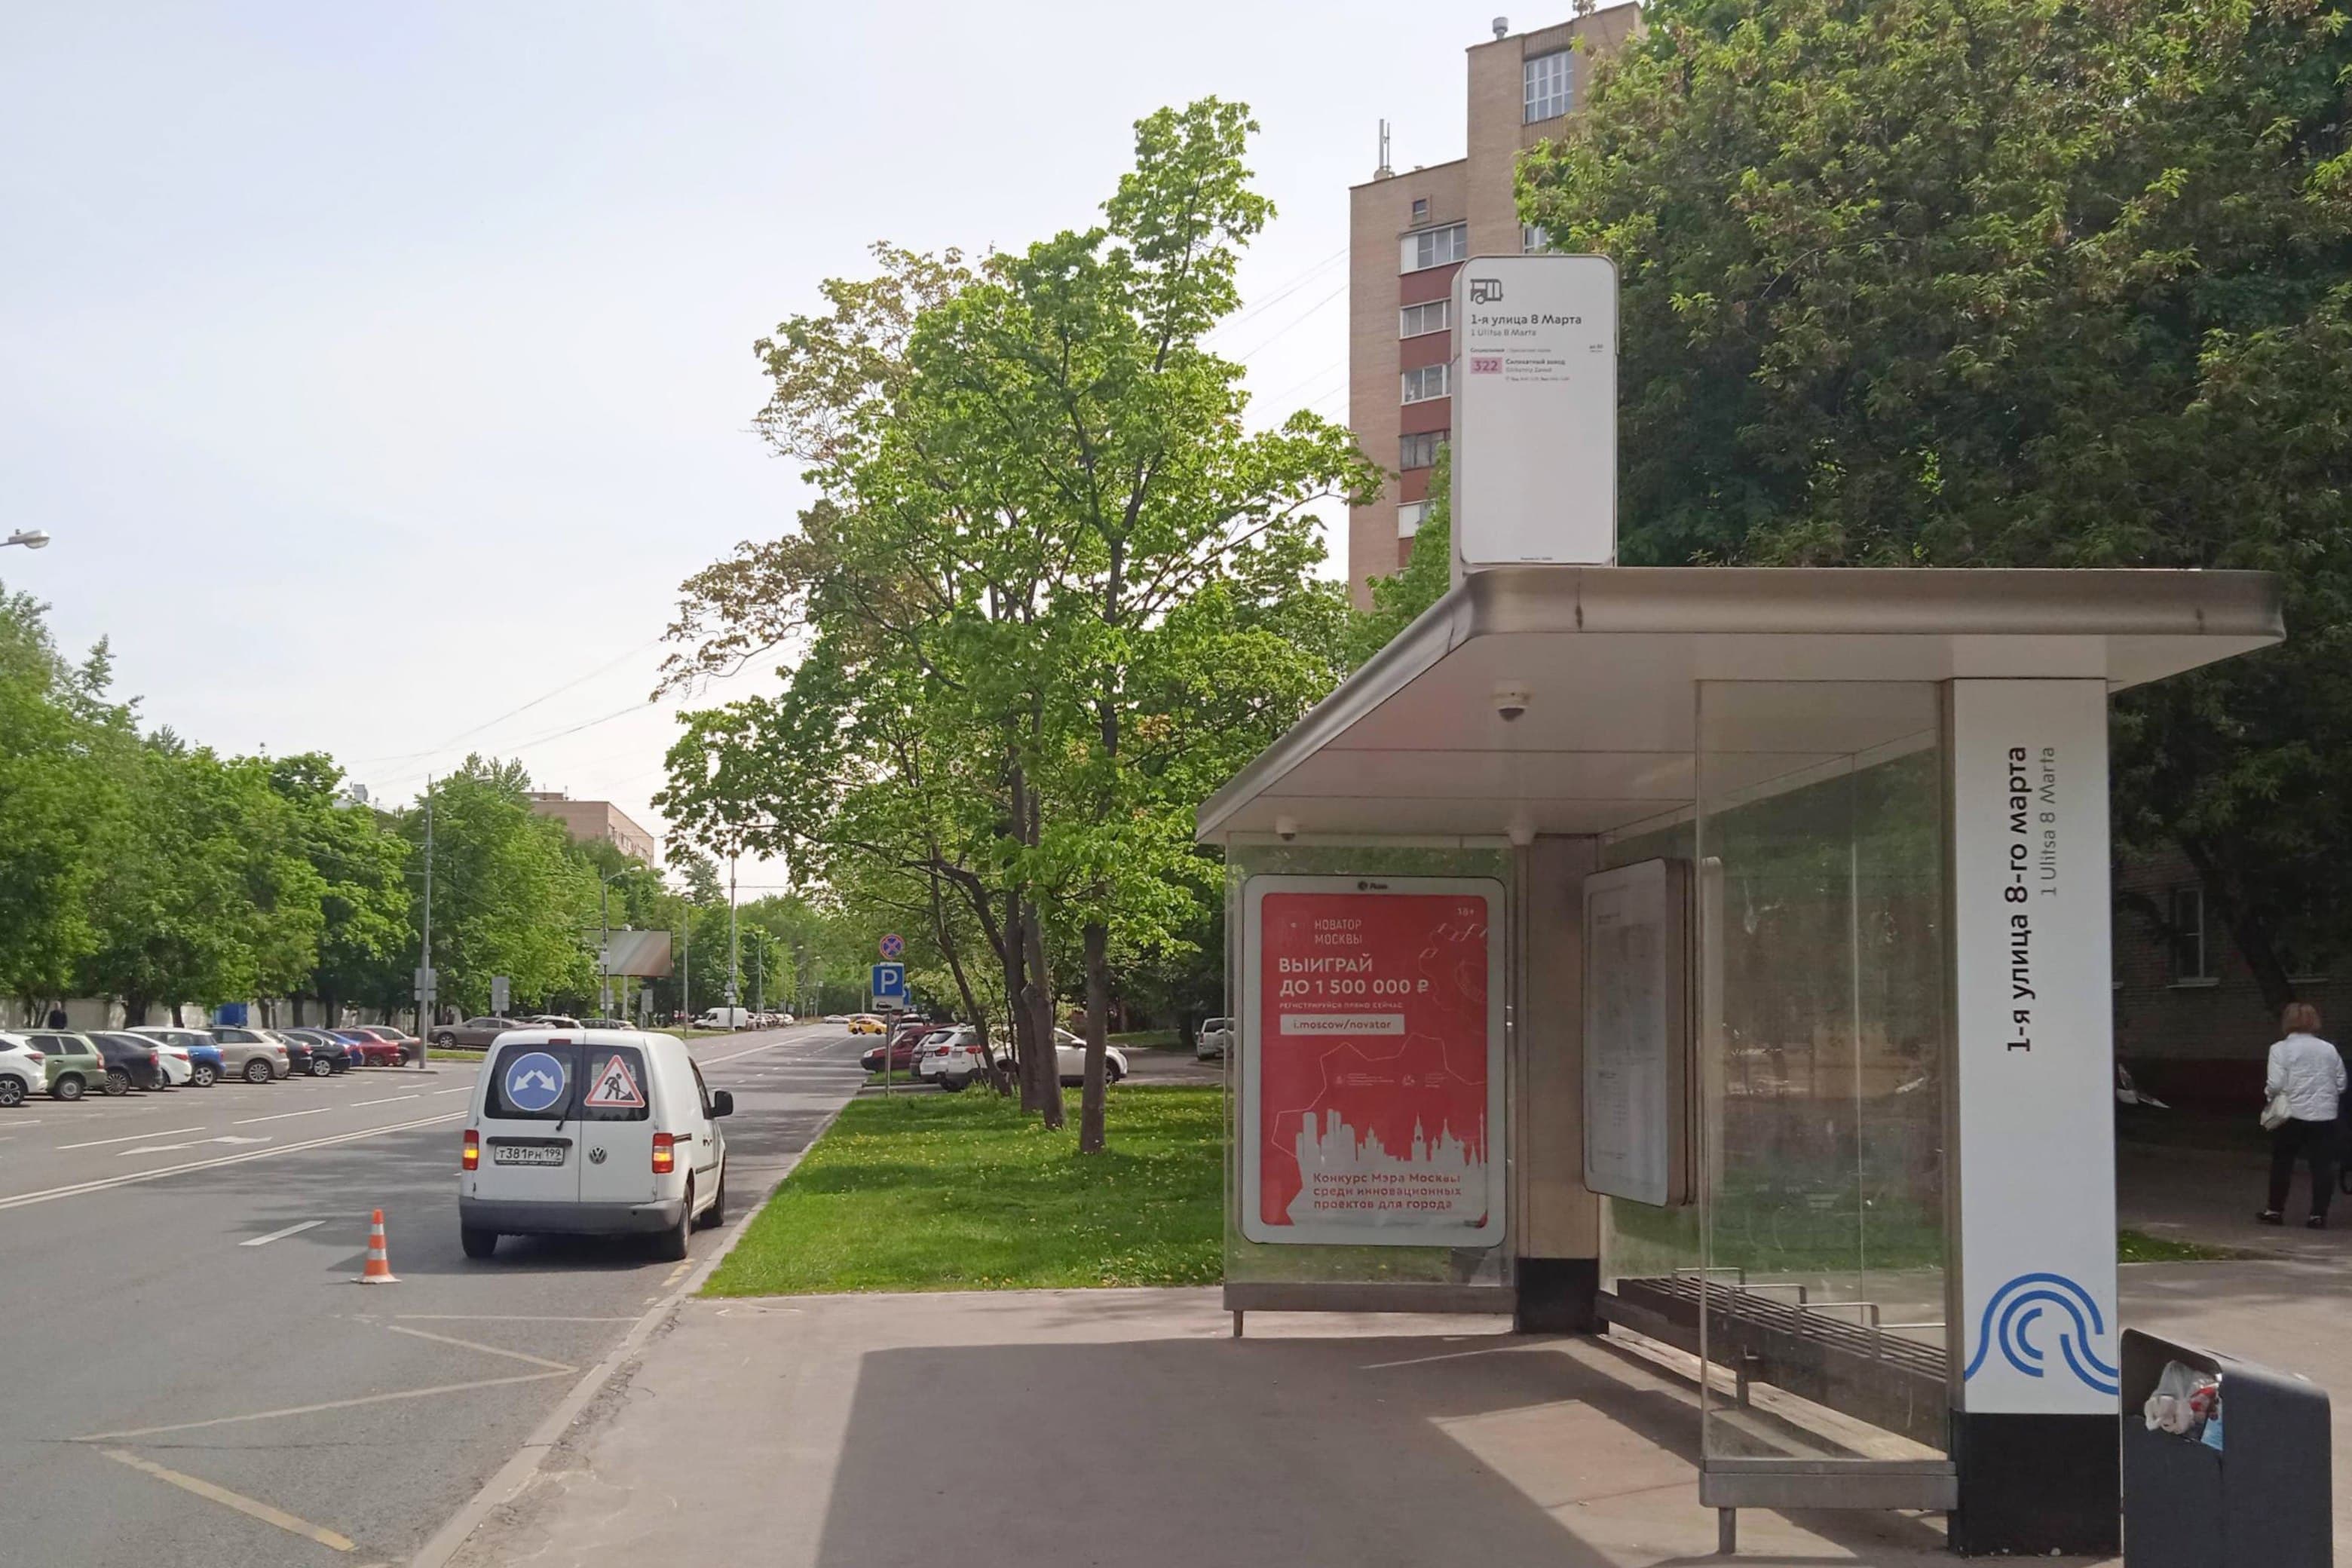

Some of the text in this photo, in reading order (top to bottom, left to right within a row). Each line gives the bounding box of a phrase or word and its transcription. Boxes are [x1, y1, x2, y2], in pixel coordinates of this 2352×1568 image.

[1472, 314, 1582, 326] 1-я улица 8 Марта
[1474, 360, 1498, 372] 322
[2039, 747, 2056, 896] 1 Ulitsa 8 Marta
[2004, 747, 2035, 1052] 1-я улица 8-го марта
[1315, 919, 1362, 929] НОВАТОР
[1315, 934, 1363, 945] МОСКВЫ
[1279, 953, 1373, 972] ВЫИГРАЙ
[880, 969, 898, 994] P
[1279, 980, 1309, 997] ДО
[1315, 981, 1323, 994] 1
[1330, 980, 1366, 994] 500
[1373, 980, 1411, 994] 000
[1294, 1019, 1392, 1030] i.moscow/novator
[1313, 1173, 1367, 1184] Конкурс
[1372, 1174, 1404, 1184] Мэра
[1313, 1188, 1462, 1197] среди инновационных
[1314, 1200, 1453, 1210] проектов для города
